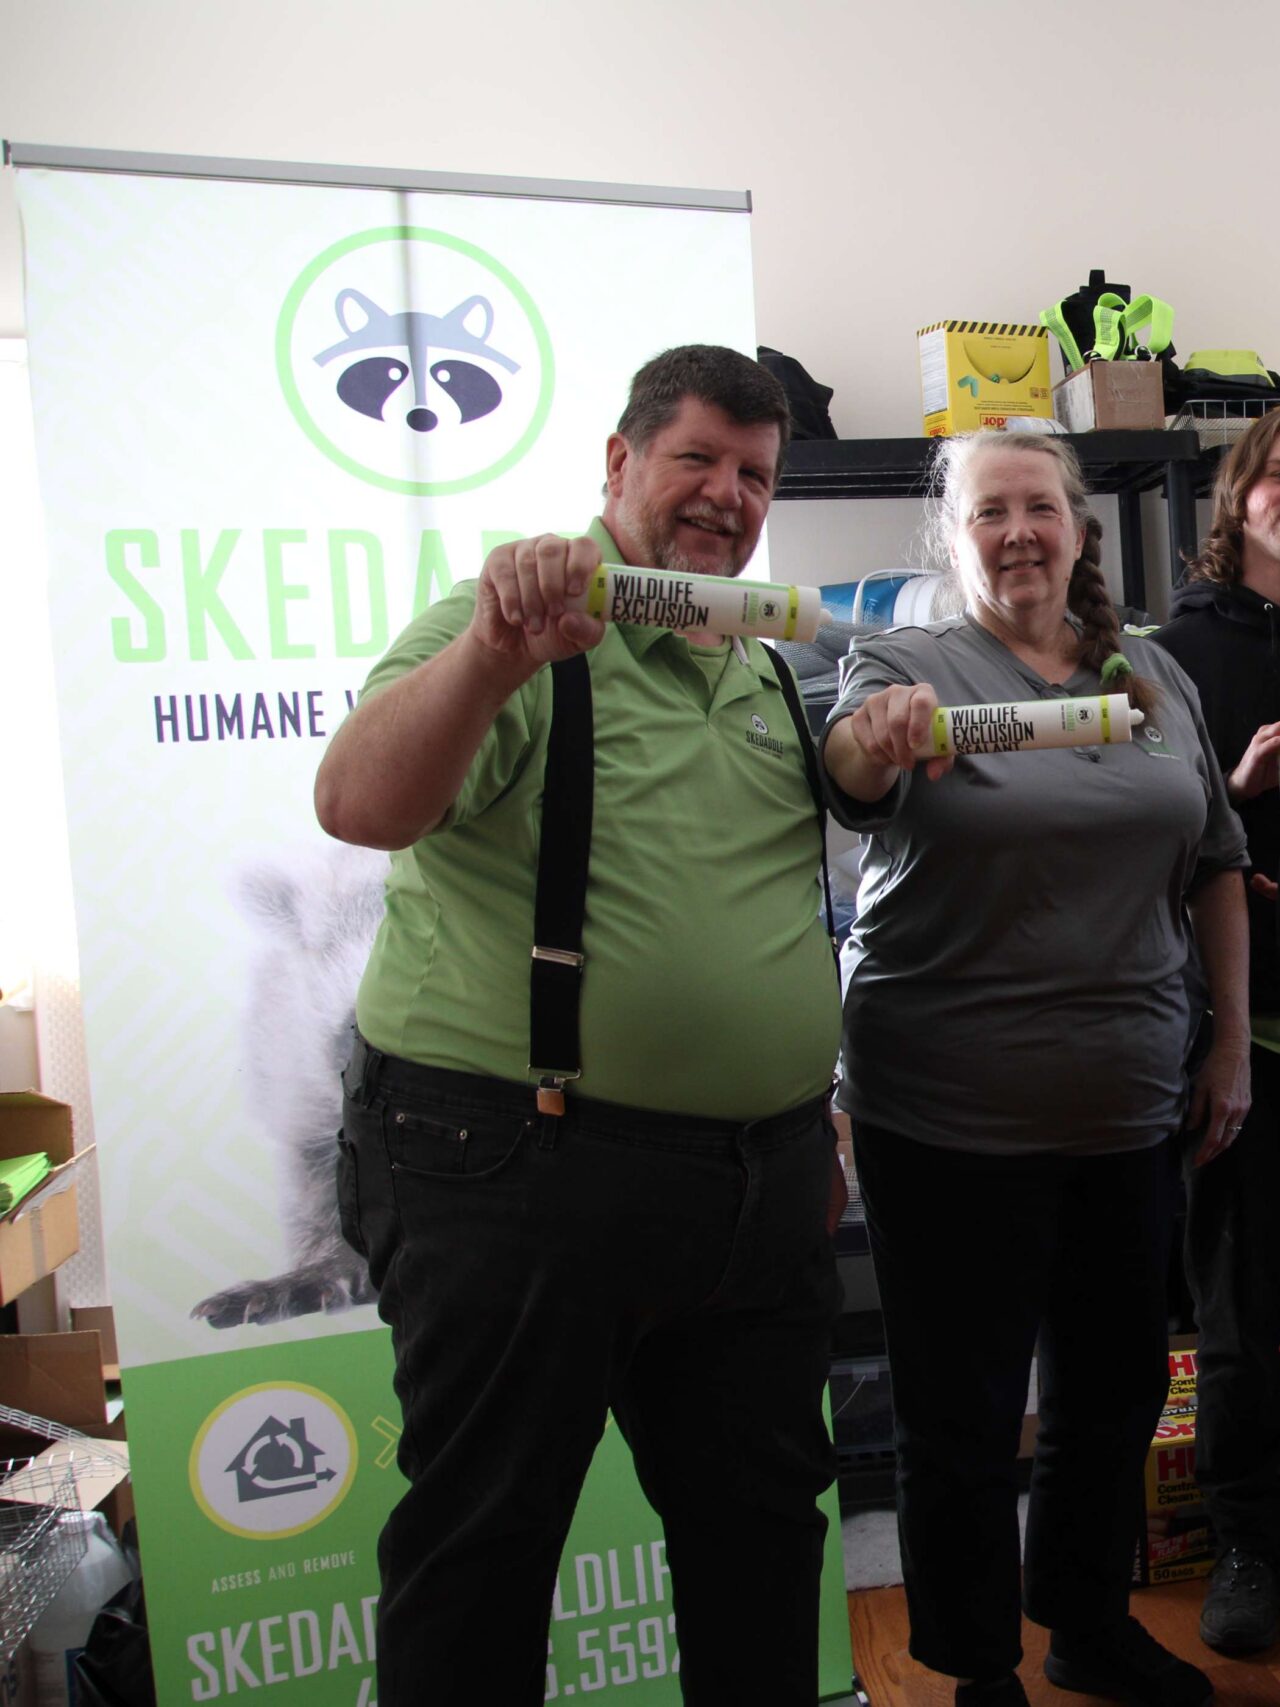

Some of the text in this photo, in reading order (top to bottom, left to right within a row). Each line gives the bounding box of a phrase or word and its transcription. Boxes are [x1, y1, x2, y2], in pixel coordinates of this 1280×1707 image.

[105, 527, 597, 664] SKEDA
[613, 573, 694, 605] WILDLIFE
[611, 596, 710, 627] EXCLUSION
[153, 690, 327, 744] HUMANE
[951, 705, 1019, 727] WILDLIFE
[952, 721, 1035, 747] EXCLUSION
[211, 1550, 357, 1594] ASSESS AND REMOVE
[1153, 1568, 1170, 1582] 50
